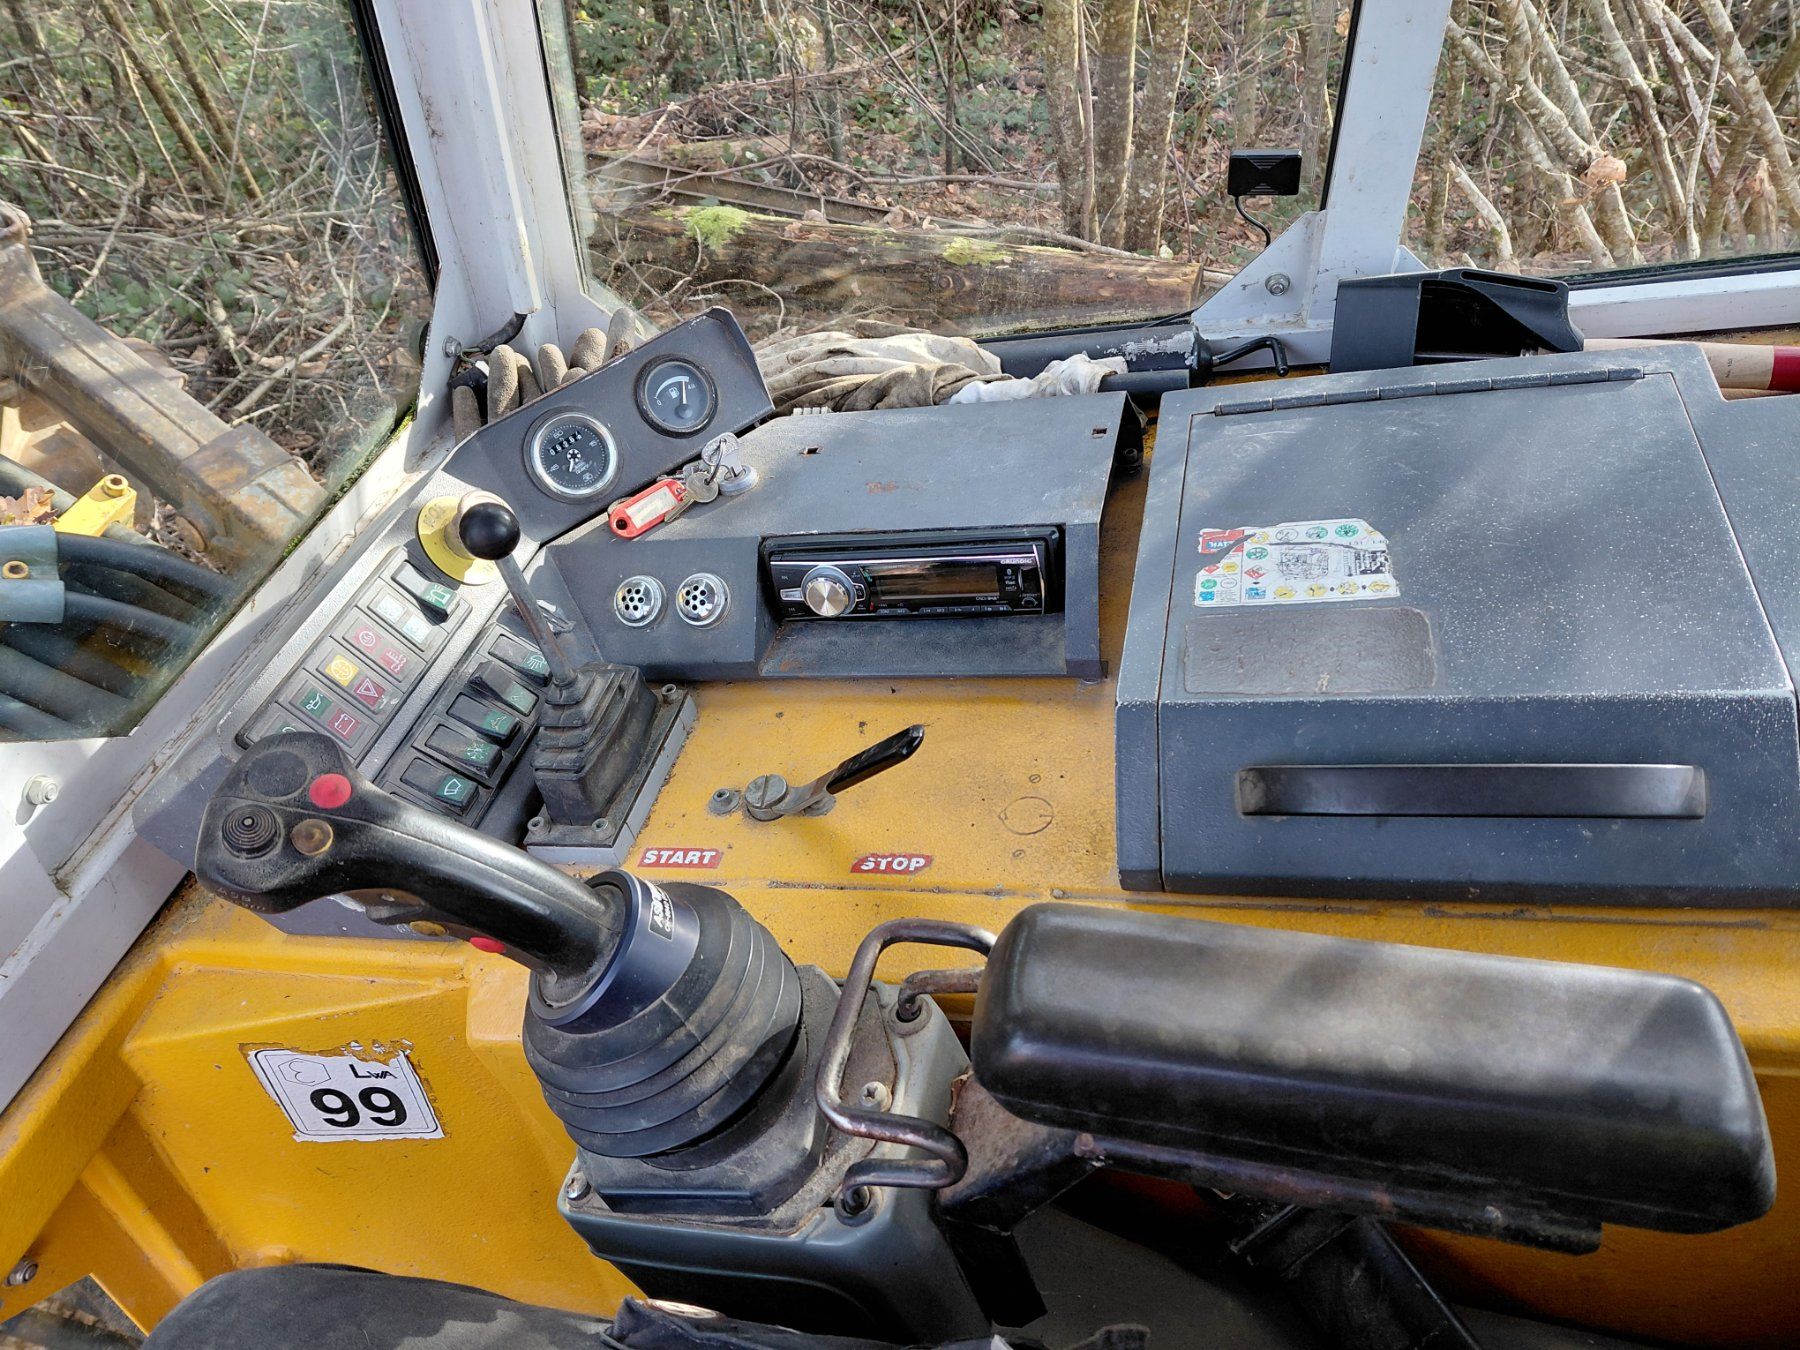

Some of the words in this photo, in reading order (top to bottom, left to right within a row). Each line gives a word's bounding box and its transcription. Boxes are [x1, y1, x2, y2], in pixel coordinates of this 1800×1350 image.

[1000, 557, 1033, 566] GRUNDIG
[643, 849, 717, 865] START
[860, 854, 926, 872] STOP
[309, 1086, 408, 1129] 99
